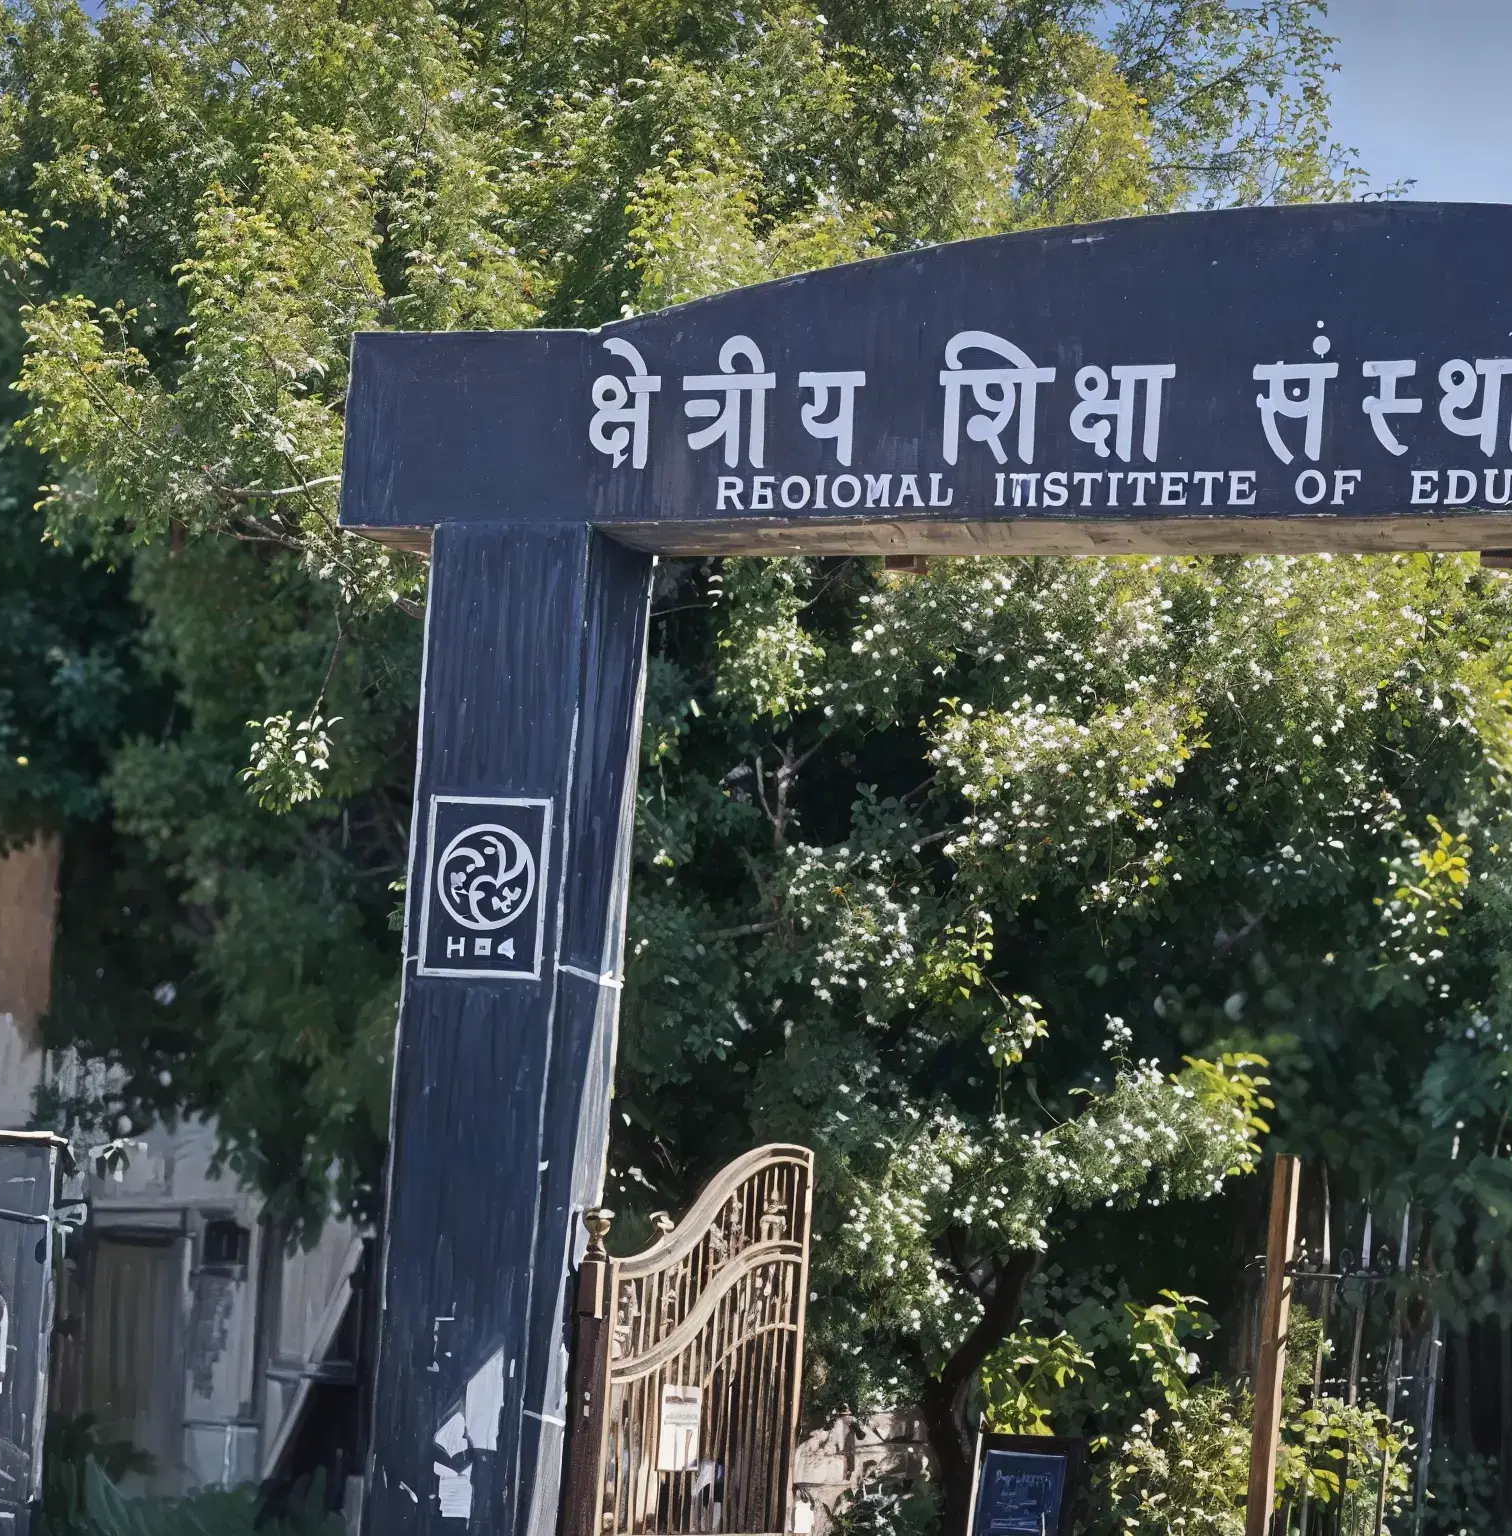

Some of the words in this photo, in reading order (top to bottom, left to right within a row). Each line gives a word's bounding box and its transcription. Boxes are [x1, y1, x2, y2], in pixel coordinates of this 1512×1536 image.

[589, 336, 866, 469] क्षेत्रीय
[940, 331, 1176, 466] शिक्षा
[1294, 468, 1361, 505] OF
